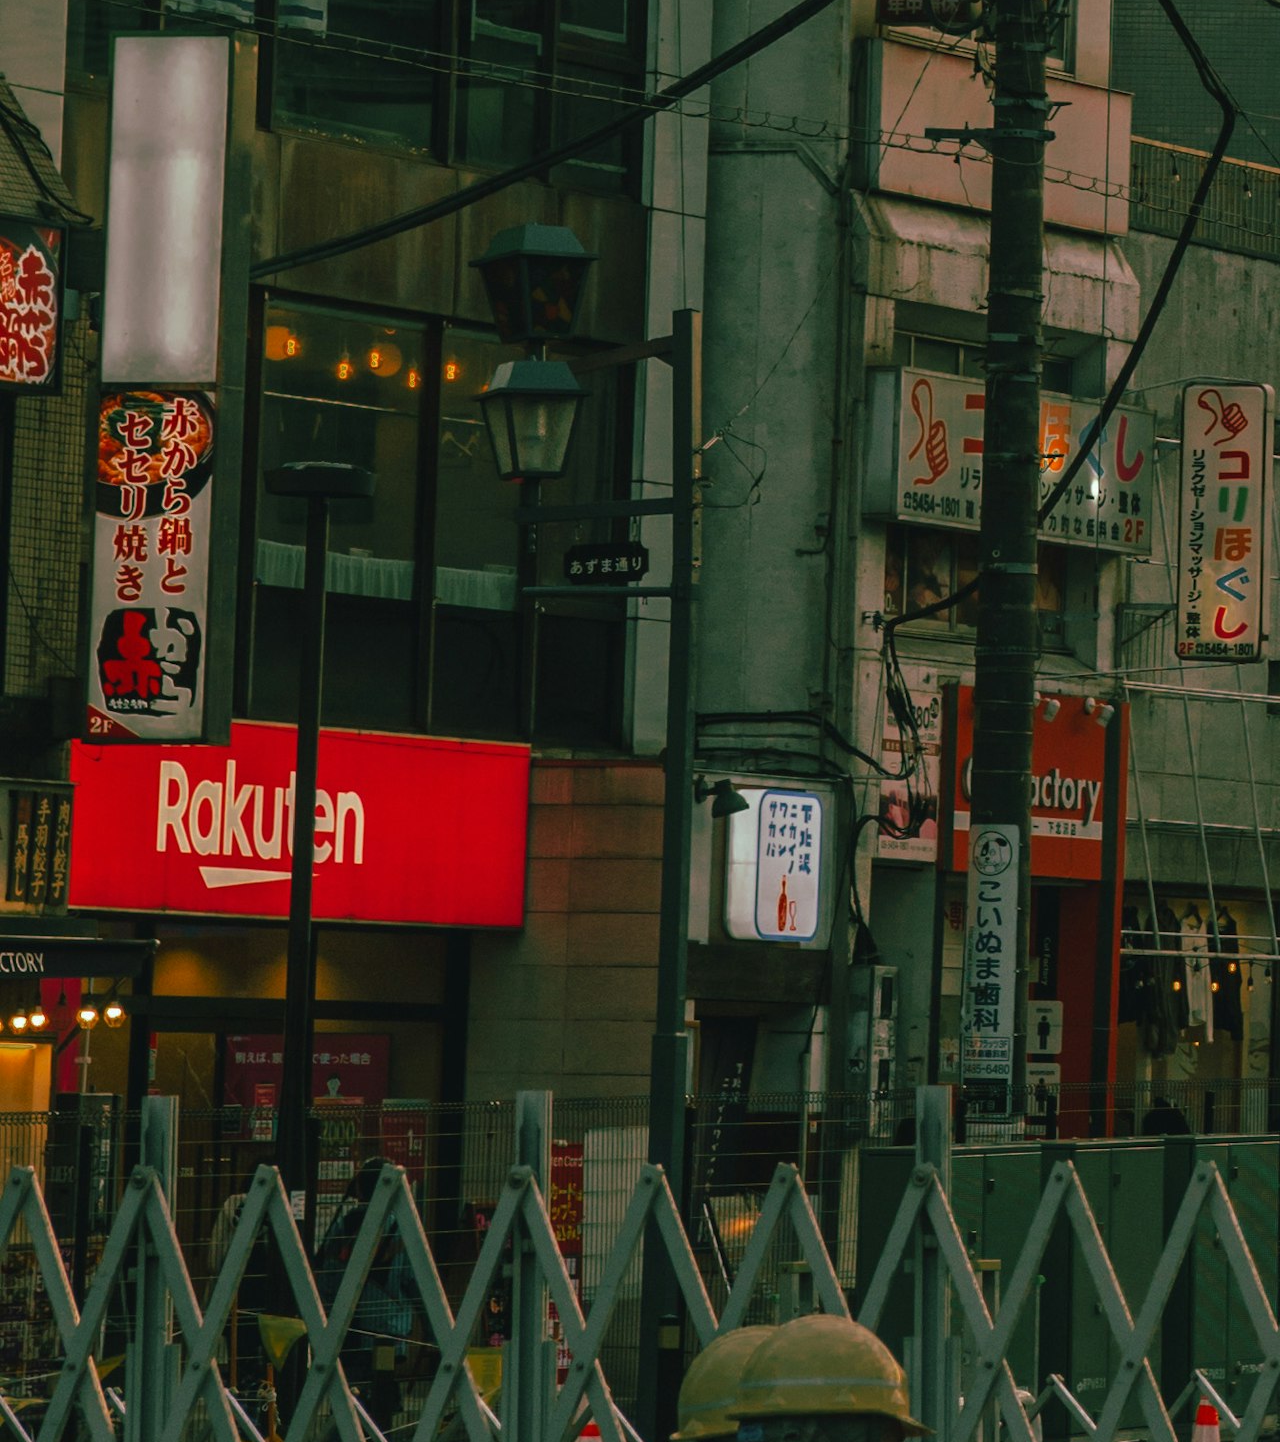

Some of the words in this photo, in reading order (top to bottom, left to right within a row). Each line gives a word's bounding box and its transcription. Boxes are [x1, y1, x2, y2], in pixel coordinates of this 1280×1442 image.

[114, 413, 154, 602] セセリ焼き
[157, 398, 199, 595] 赤から鍋と
[1125, 519, 1145, 544] 2F
[1214, 450, 1253, 640] コリほぐし
[570, 557, 642, 574] あずま通り
[1179, 642, 1194, 654] 2F
[89, 716, 114, 735] 2F
[15, 823, 29, 896] 馬刺し
[31, 797, 51, 897] 手羽餃子
[53, 800, 70, 899] 肉汁餃子
[972, 880, 1002, 1033] こいぬま歯科
